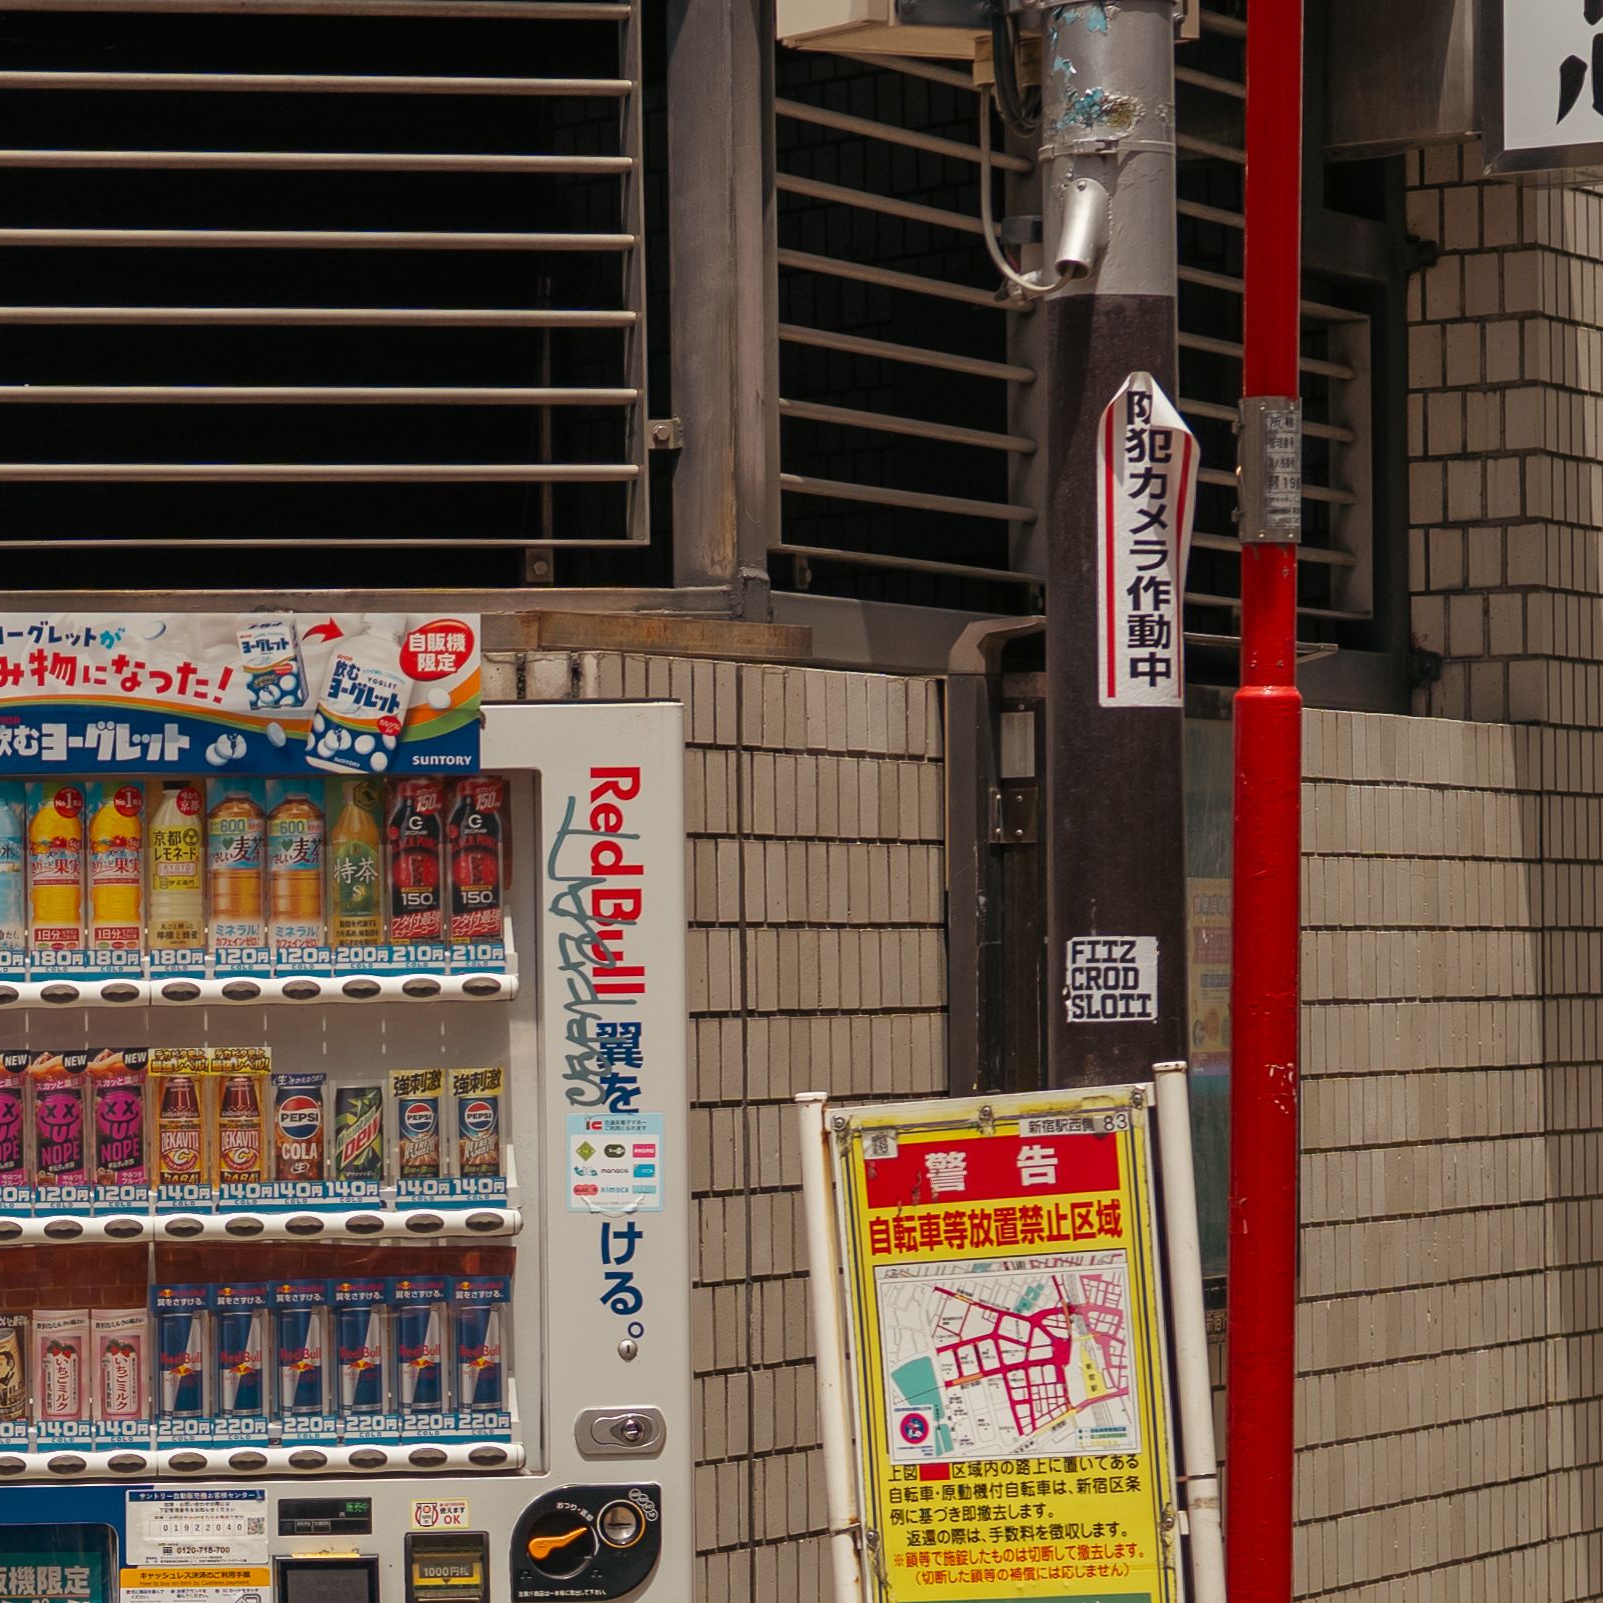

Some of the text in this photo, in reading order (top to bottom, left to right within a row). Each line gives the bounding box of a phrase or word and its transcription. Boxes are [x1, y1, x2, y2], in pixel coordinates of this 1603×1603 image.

[408, 633, 466, 653] 自販機
[333, 660, 361, 681] 飲む
[416, 653, 458, 673] 限定
[412, 755, 473, 766] SUNTORY
[220, 820, 244, 833] 600
[280, 820, 305, 834] 600
[590, 767, 644, 875] Red
[153, 830, 182, 846] 京都
[154, 848, 197, 862] レモネード
[333, 857, 379, 884] 特茶
[401, 893, 432, 906] 150
[215, 925, 260, 937] ミネラル!
[592, 889, 646, 994] Bull
[151, 948, 205, 965] 180円
[337, 949, 388, 963] 200円
[393, 947, 443, 961] 210円
[1071, 966, 1139, 991] CROD
[64, 1053, 88, 1066] NEW
[124, 1052, 148, 1066] NEW
[394, 1069, 441, 1095] 強刺激
[454, 1068, 501, 1095] 強刺激
[280, 1112, 319, 1123] PEPSI
[1103, 1113, 1129, 1132] 83
[100, 1138, 140, 1161] NOPE
[281, 1143, 318, 1160] COLA
[869, 1199, 1123, 1256] 自転車等放置禁止区域
[54, 1357, 69, 1412] いちごミルク
[284, 1418, 334, 1433] 220円
[952, 1454, 1139, 1478] 区域内の路上に置いてある
[889, 1475, 1142, 1504] 自転車・原動機付自転車は、新宿区条
[444, 1515, 460, 1525] OK
[890, 1502, 1055, 1526] 例に基づき即撤去します。
[906, 1521, 1129, 1547] 返還の際は、手数料を徴収します。
[176, 1546, 231, 1555] 0120-718-700
[423, 1566, 469, 1577] 1000円札
